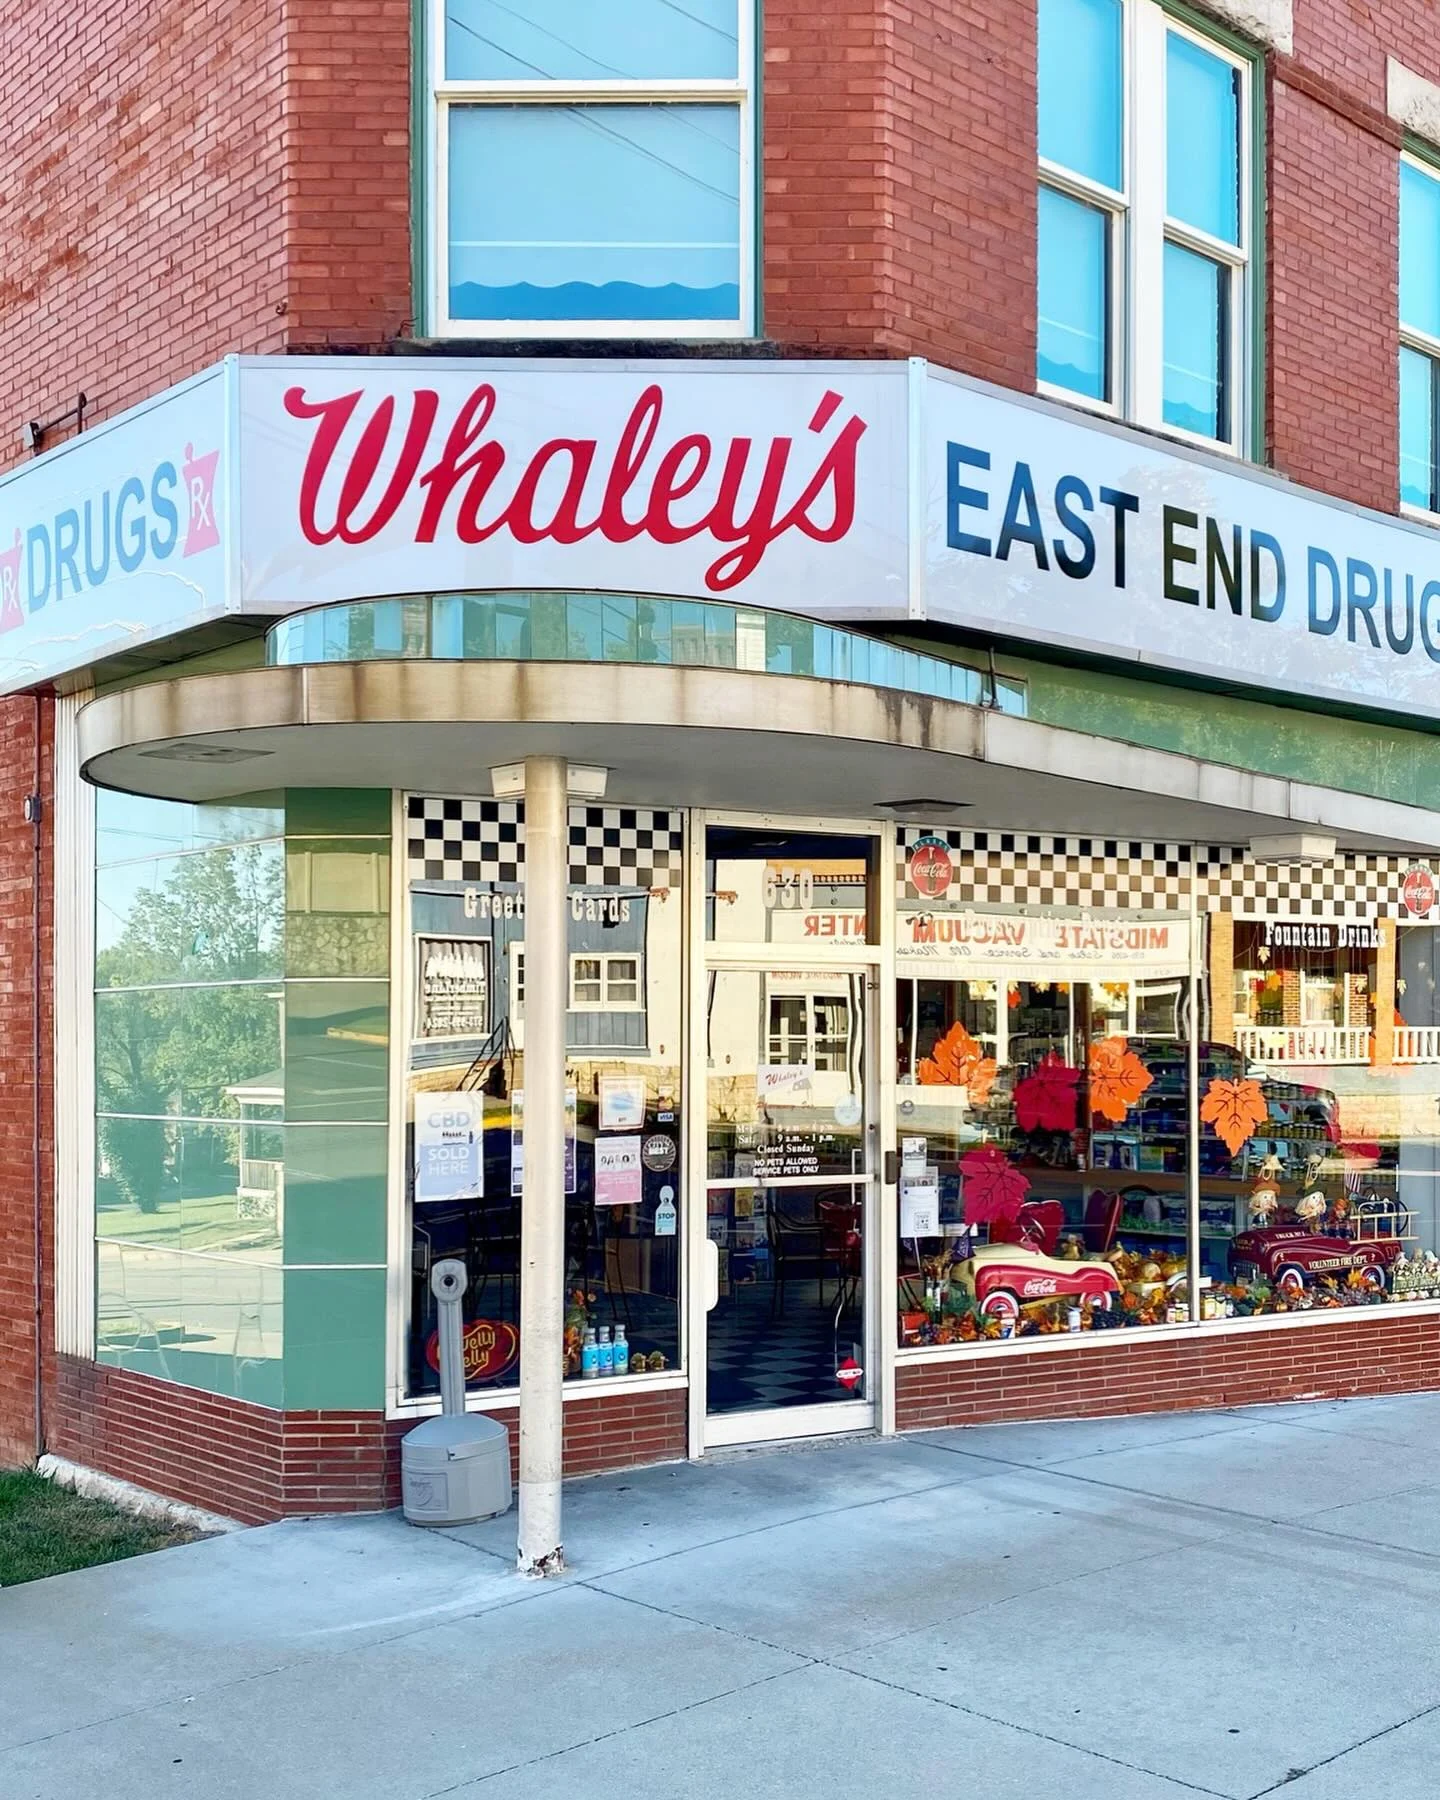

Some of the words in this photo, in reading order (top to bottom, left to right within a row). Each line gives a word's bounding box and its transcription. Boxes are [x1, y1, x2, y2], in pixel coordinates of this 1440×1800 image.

[284, 383, 868, 591] Whaley's
[26, 460, 178, 614] DRUGS
[946, 440, 1139, 589] EAST
[1162, 503, 1287, 623] END
[913, 862, 951, 878] Coca-Cola
[762, 866, 814, 909] 630
[464, 888, 524, 919] Greet
[571, 891, 630, 923] Cards
[1265, 923, 1331, 947] Fountain
[1338, 925, 1386, 949] Drinks
[427, 1111, 470, 1128] CBD
[777, 1134, 783, 1143] 9
[785, 1134, 802, 1142] a.m.
[428, 1147, 470, 1161] SOLD
[757, 1144, 783, 1153] Closed
[786, 1143, 815, 1153] Sunday
[429, 1160, 469, 1176] HERE
[752, 1167, 781, 1175] SERVICE
[783, 1166, 800, 1174] PETS
[802, 1165, 819, 1173] ONLY
[754, 1159, 765, 1167] NO
[767, 1158, 784, 1166] PETS
[786, 1157, 818, 1165] ALLOWED
[658, 1212, 675, 1220] STOP
[1308, 1257, 1340, 1270] VOLUNTEER
[1341, 1256, 1352, 1266] FIRE
[464, 1350, 489, 1368] elly
